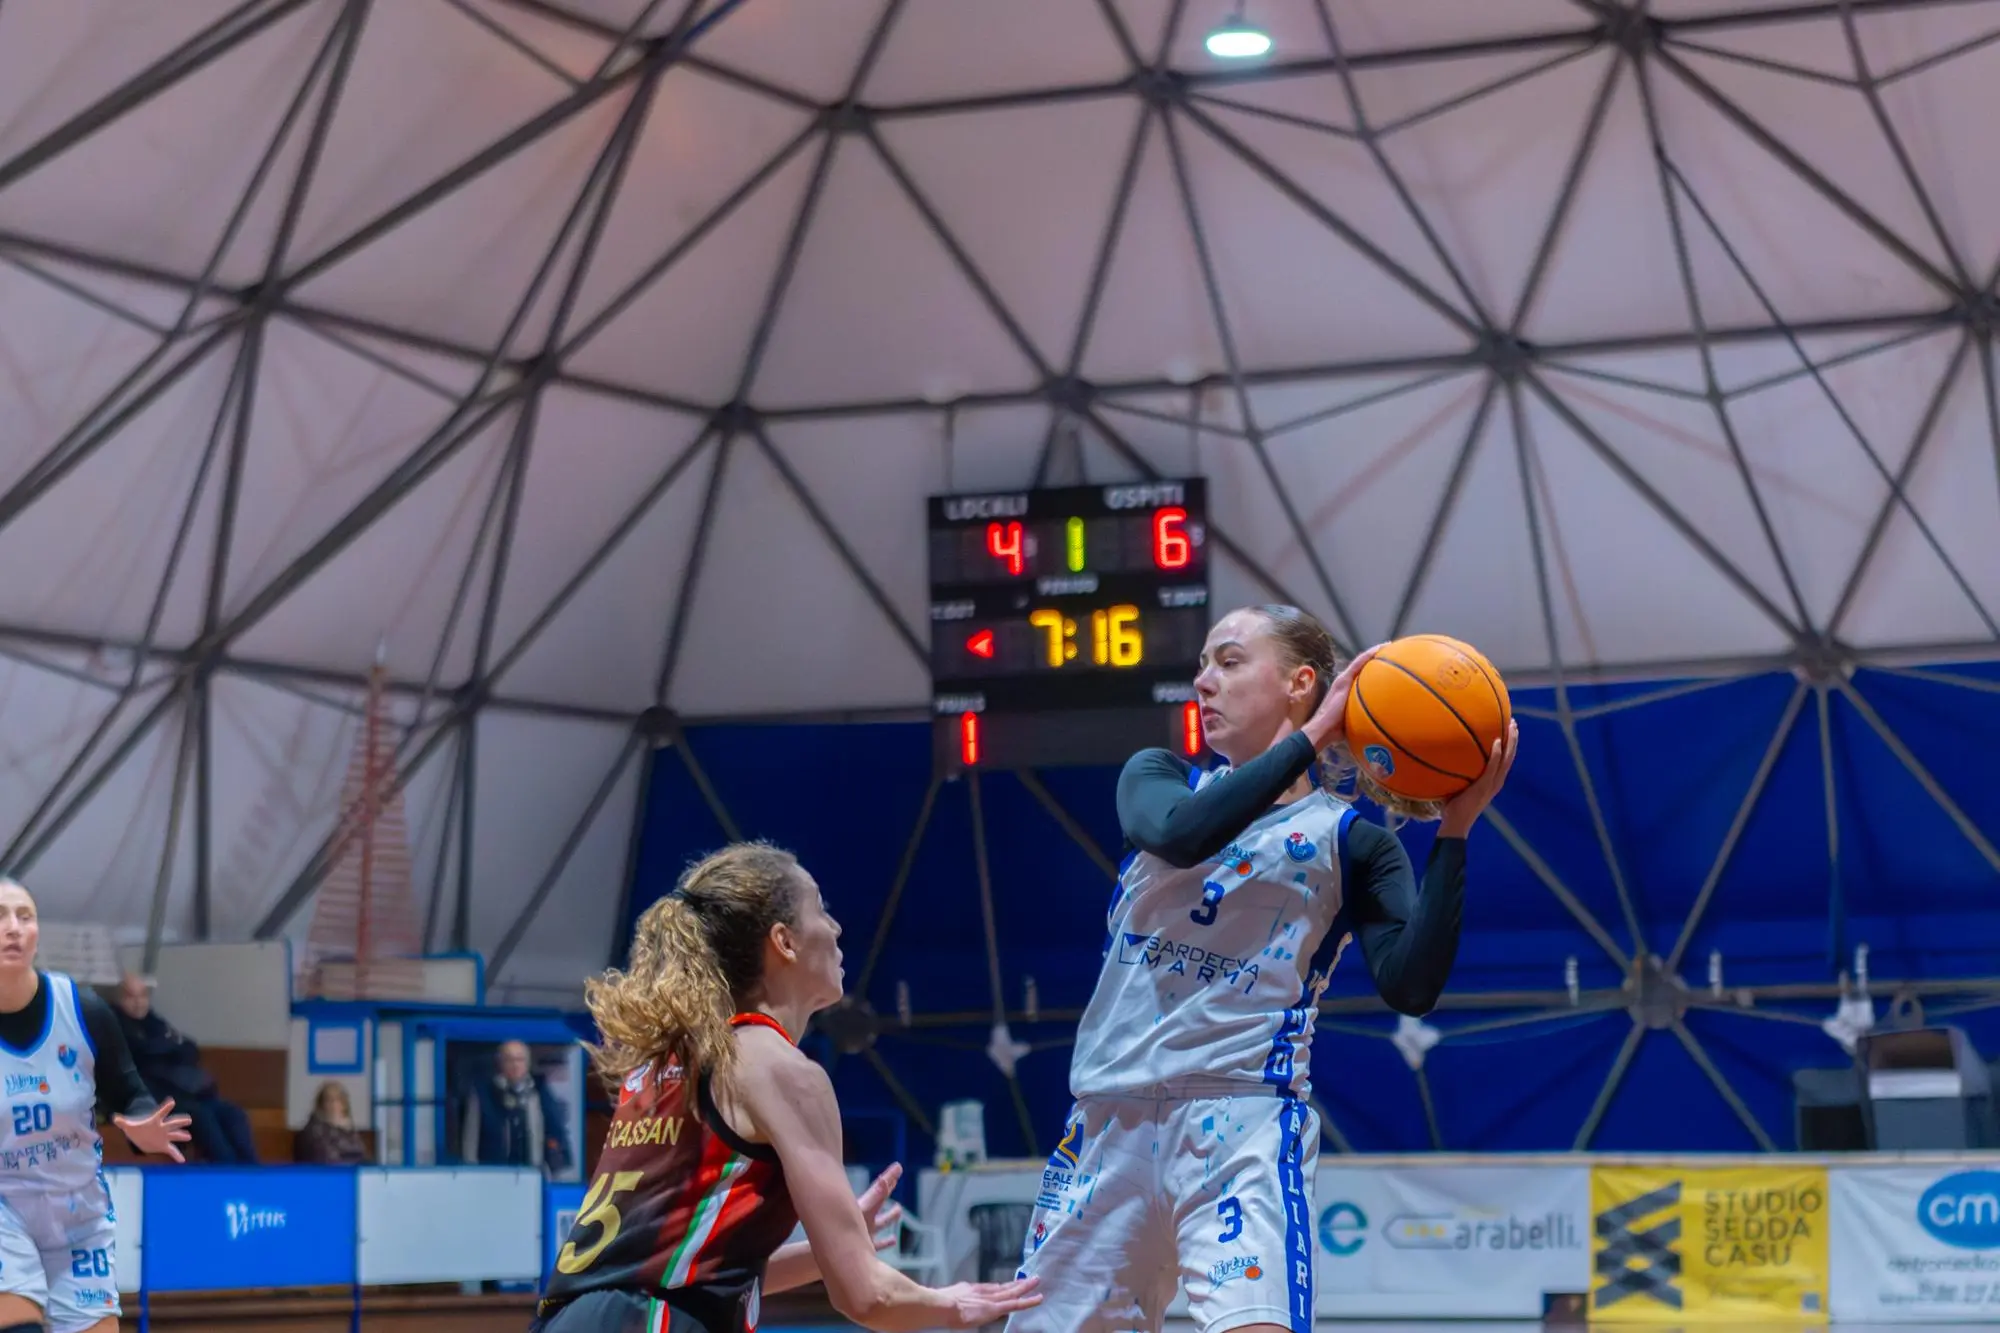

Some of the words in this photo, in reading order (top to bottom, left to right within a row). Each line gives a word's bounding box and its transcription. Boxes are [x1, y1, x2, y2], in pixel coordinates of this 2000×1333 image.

[943, 495, 1028, 520] LOCALI
[1104, 484, 1184, 509] OSPITI
[986, 520, 1023, 575] 4
[1066, 516, 1084, 571] 1
[1153, 507, 1191, 570] 6
[1030, 604, 1143, 667] 7:16
[962, 711, 977, 764] 1
[1184, 700, 1199, 755] 1
[1190, 881, 1225, 925] 3
[12, 1103, 52, 1136] 20
[611, 1116, 684, 1149] CASSAN
[1218, 1197, 1243, 1243] 3
[1704, 1188, 1822, 1215] STUDIO
[1704, 1216, 1811, 1241] SEDDA
[71, 1248, 109, 1278] 20
[1704, 1243, 1791, 1267] CASU
